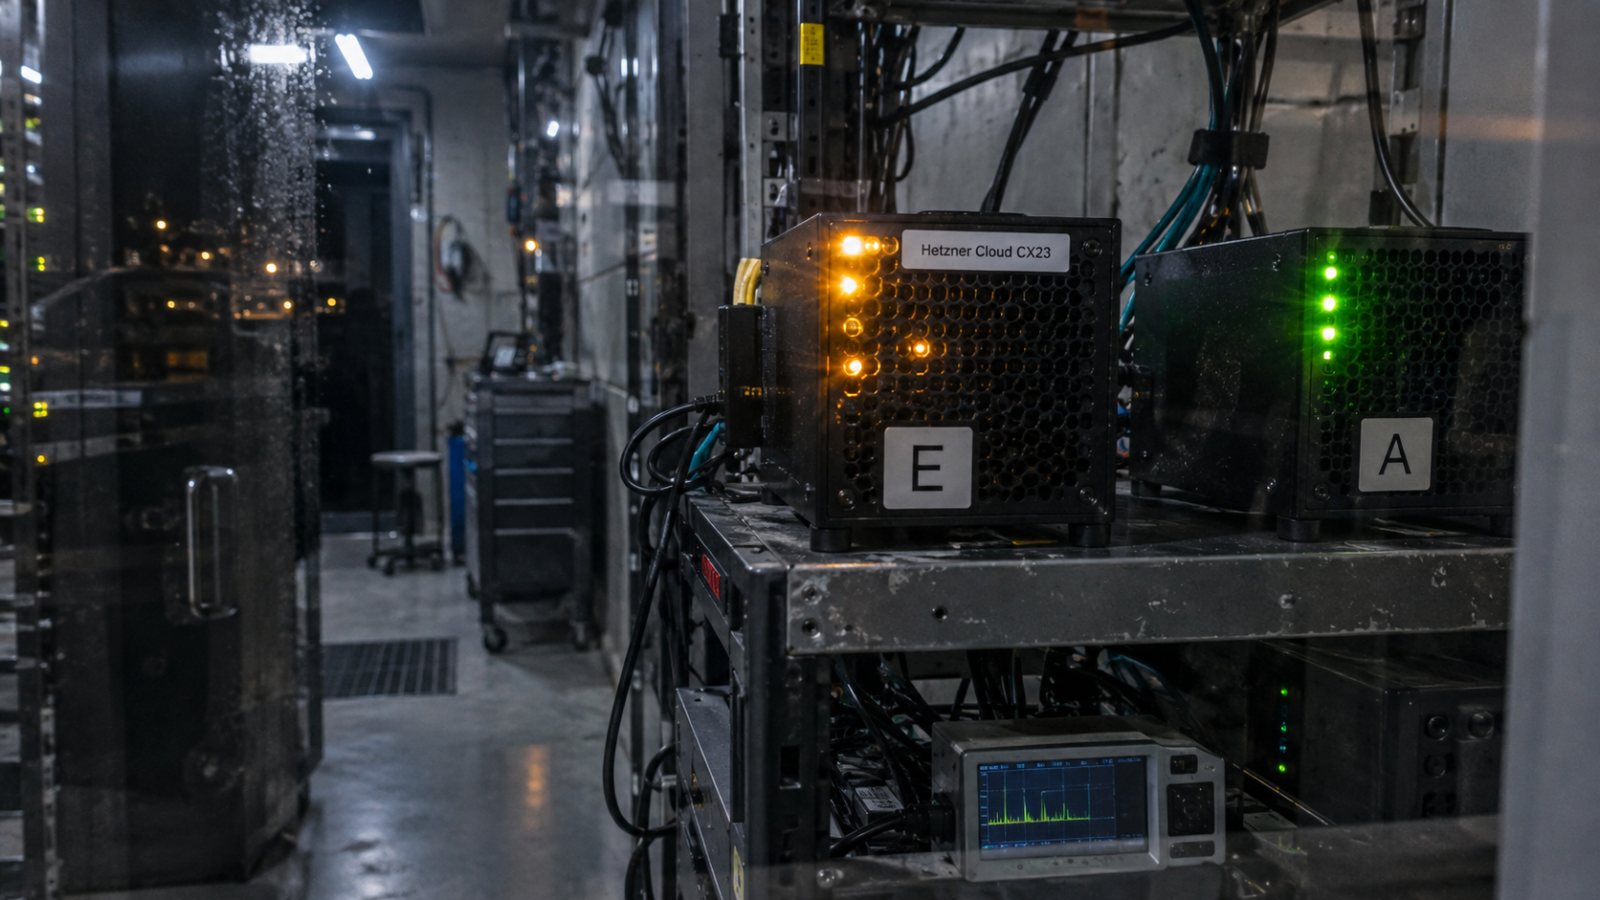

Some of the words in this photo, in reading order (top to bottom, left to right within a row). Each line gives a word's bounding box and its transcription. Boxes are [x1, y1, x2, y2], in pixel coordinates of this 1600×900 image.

[921, 243, 972, 258] Hetzner
[975, 244, 1013, 258] Cloud
[1016, 245, 1052, 259] CX23
[911, 444, 944, 492] E
[1378, 433, 1412, 475] A
